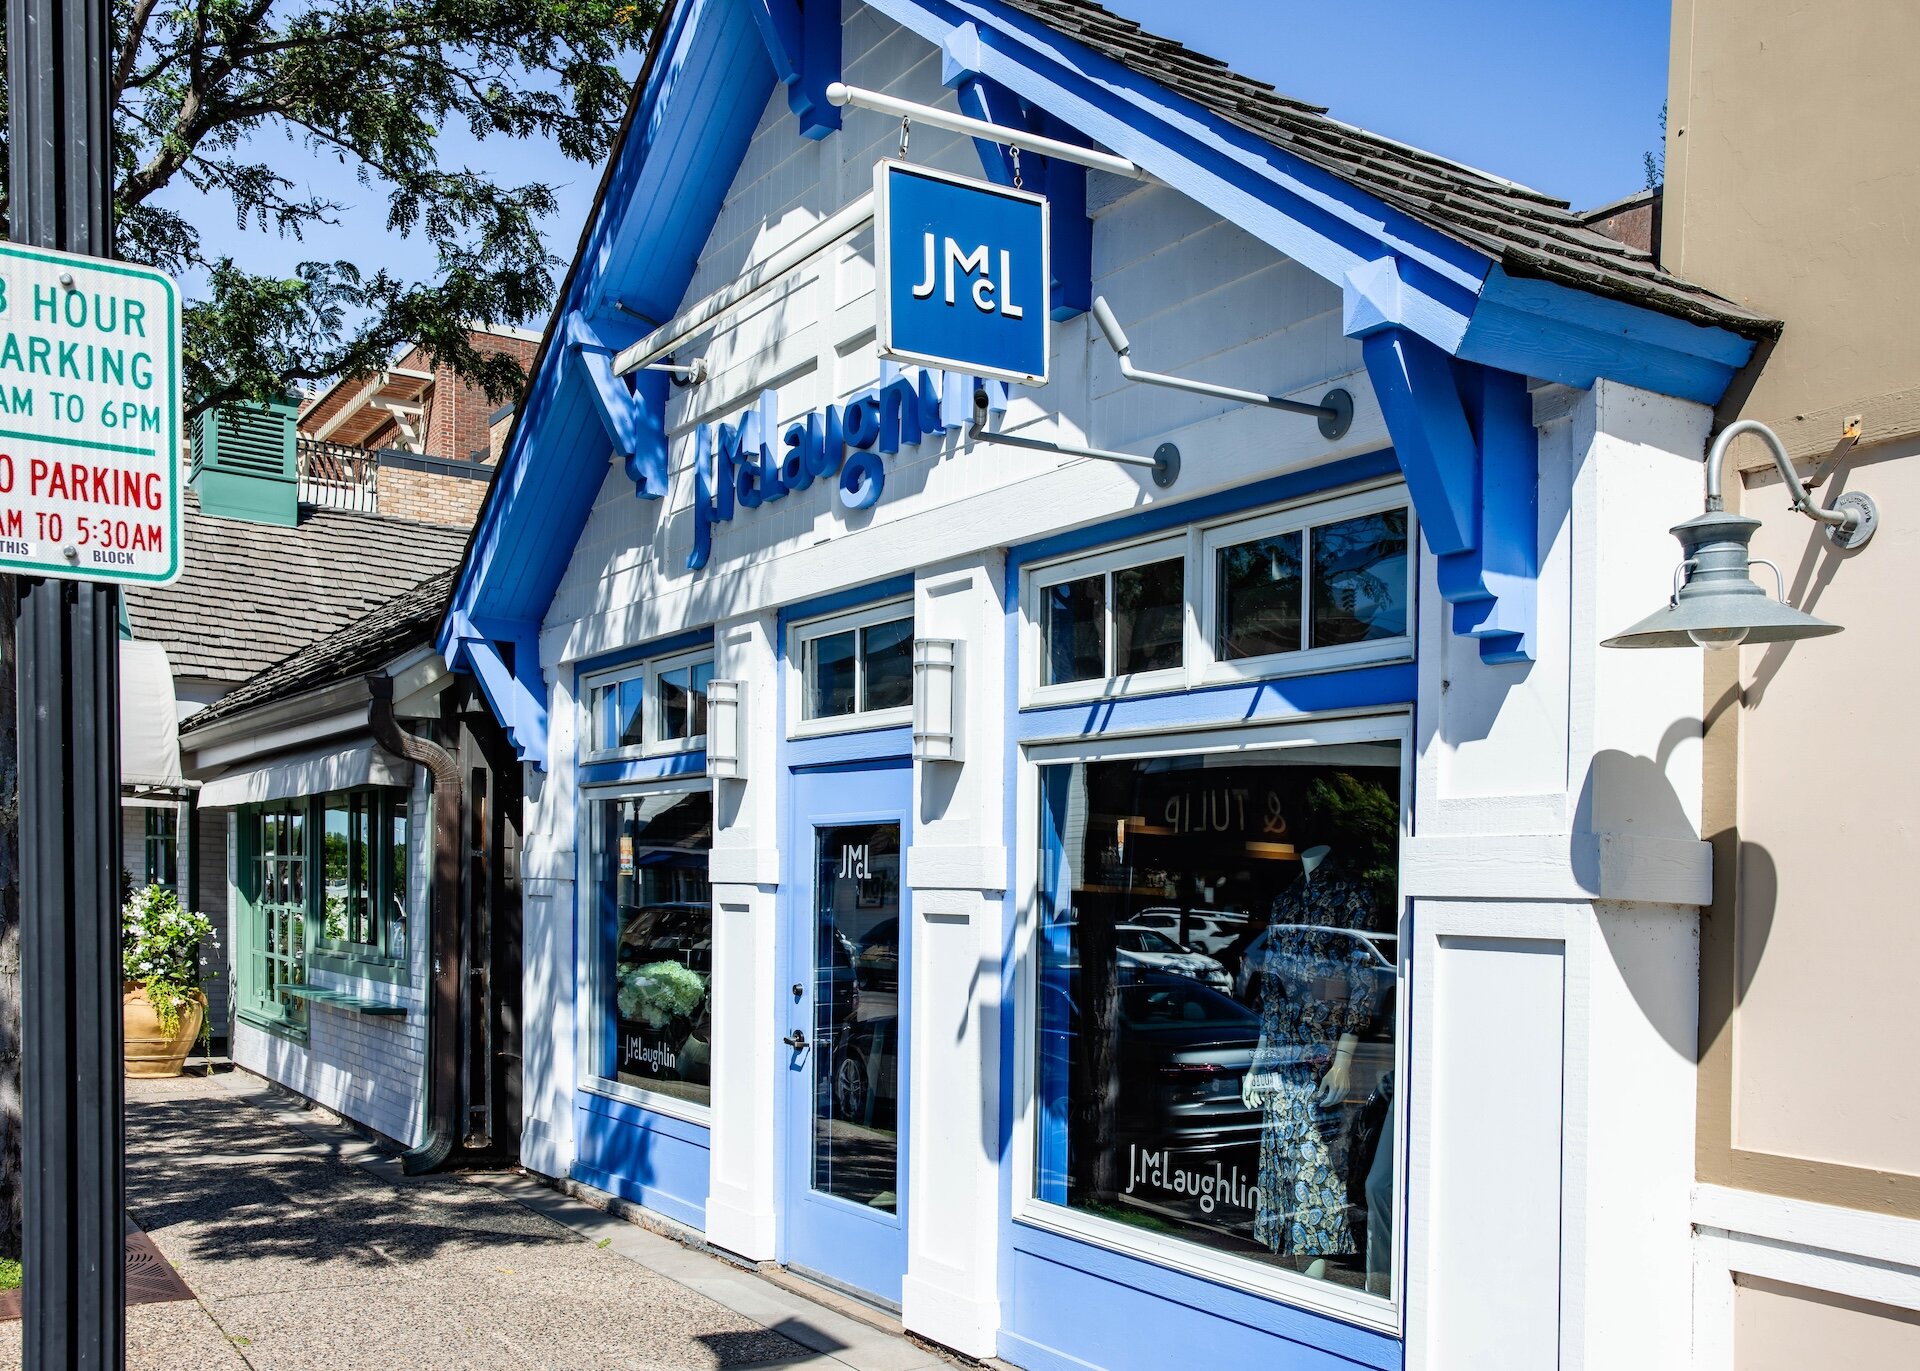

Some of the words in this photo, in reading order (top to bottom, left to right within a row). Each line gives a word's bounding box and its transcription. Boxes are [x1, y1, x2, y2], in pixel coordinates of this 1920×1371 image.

[34, 284, 145, 337] HOUR
[0, 332, 152, 390] ARKING
[50, 391, 84, 424] TO
[101, 400, 160, 434] 6PM
[0, 454, 14, 493] O
[31, 459, 161, 511] PARKING
[36, 512, 62, 542] TO
[78, 517, 162, 553] 5:30AM
[93, 550, 135, 566] BLOCK
[624, 1034, 676, 1073] J.McLaughlin
[1126, 1143, 1261, 1213] J.McLaughlin
